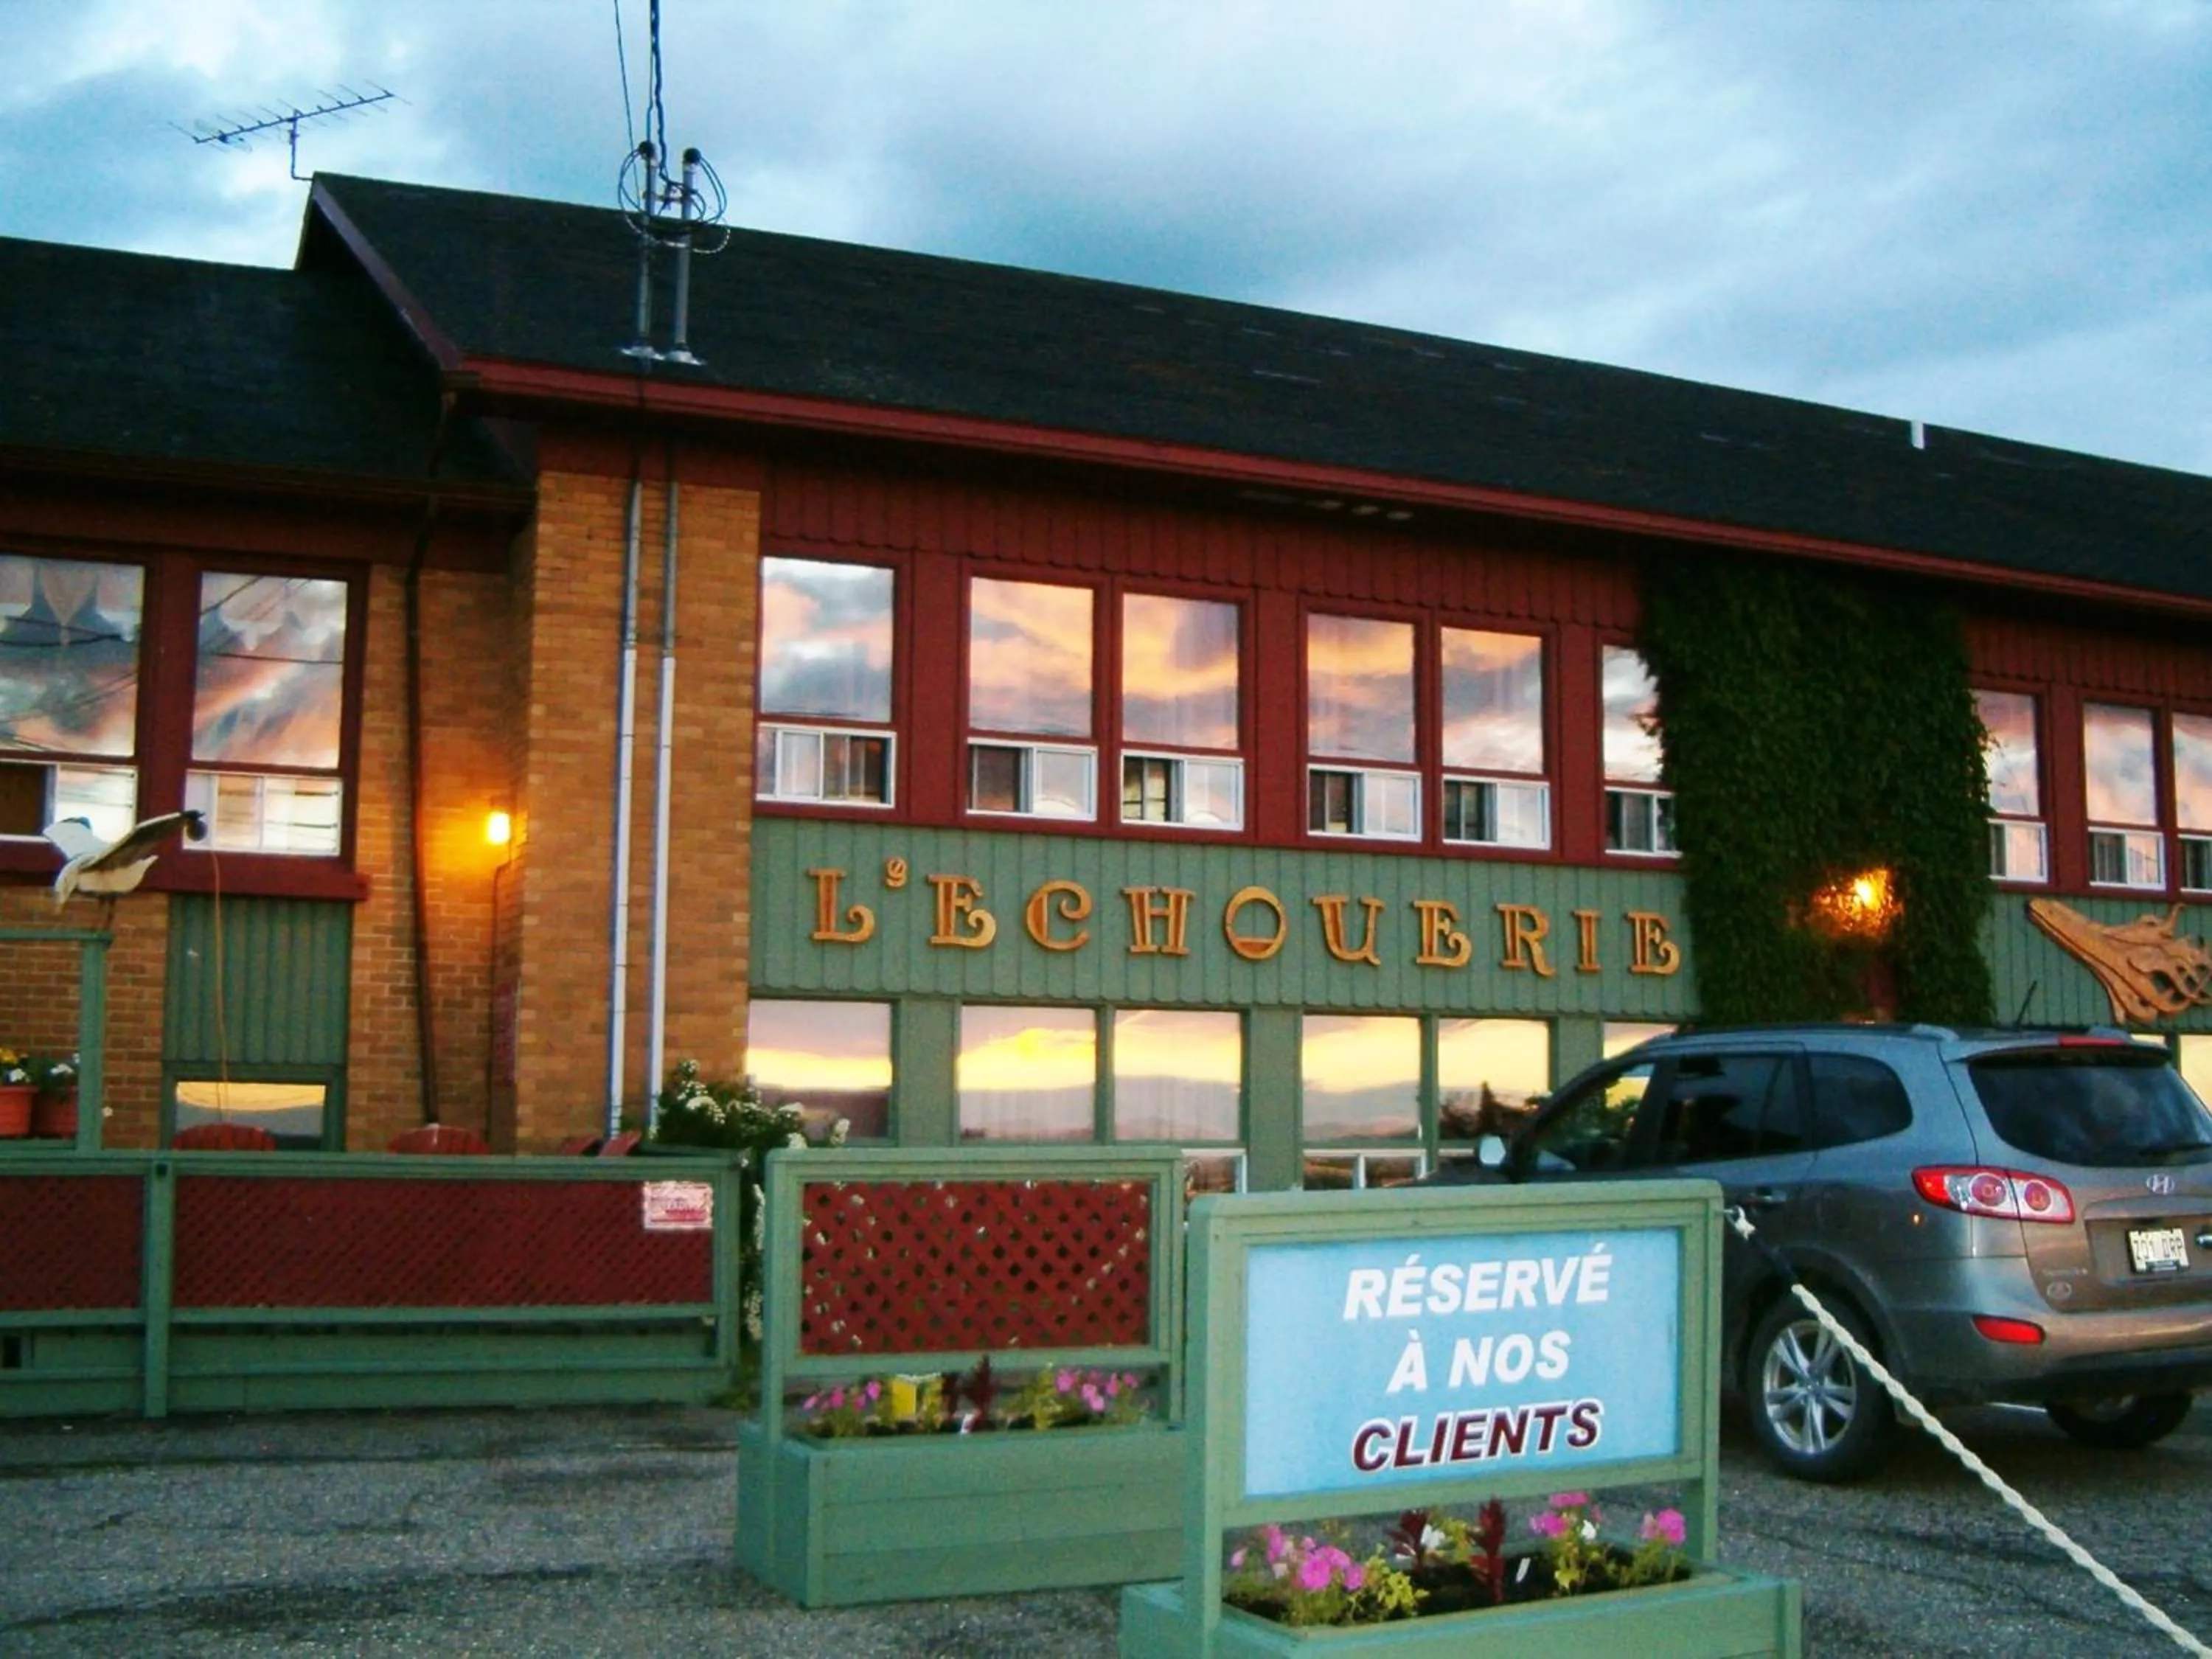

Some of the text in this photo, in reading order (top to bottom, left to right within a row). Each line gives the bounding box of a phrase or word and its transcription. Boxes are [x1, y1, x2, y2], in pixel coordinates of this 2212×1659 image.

[807, 856, 1680, 976] L'ECHOUERIE
[1343, 1242, 1613, 1320] RÉSERVÉ
[1387, 1329, 1571, 1394] À NOS
[1352, 1398, 1604, 1472] CLIENTS
